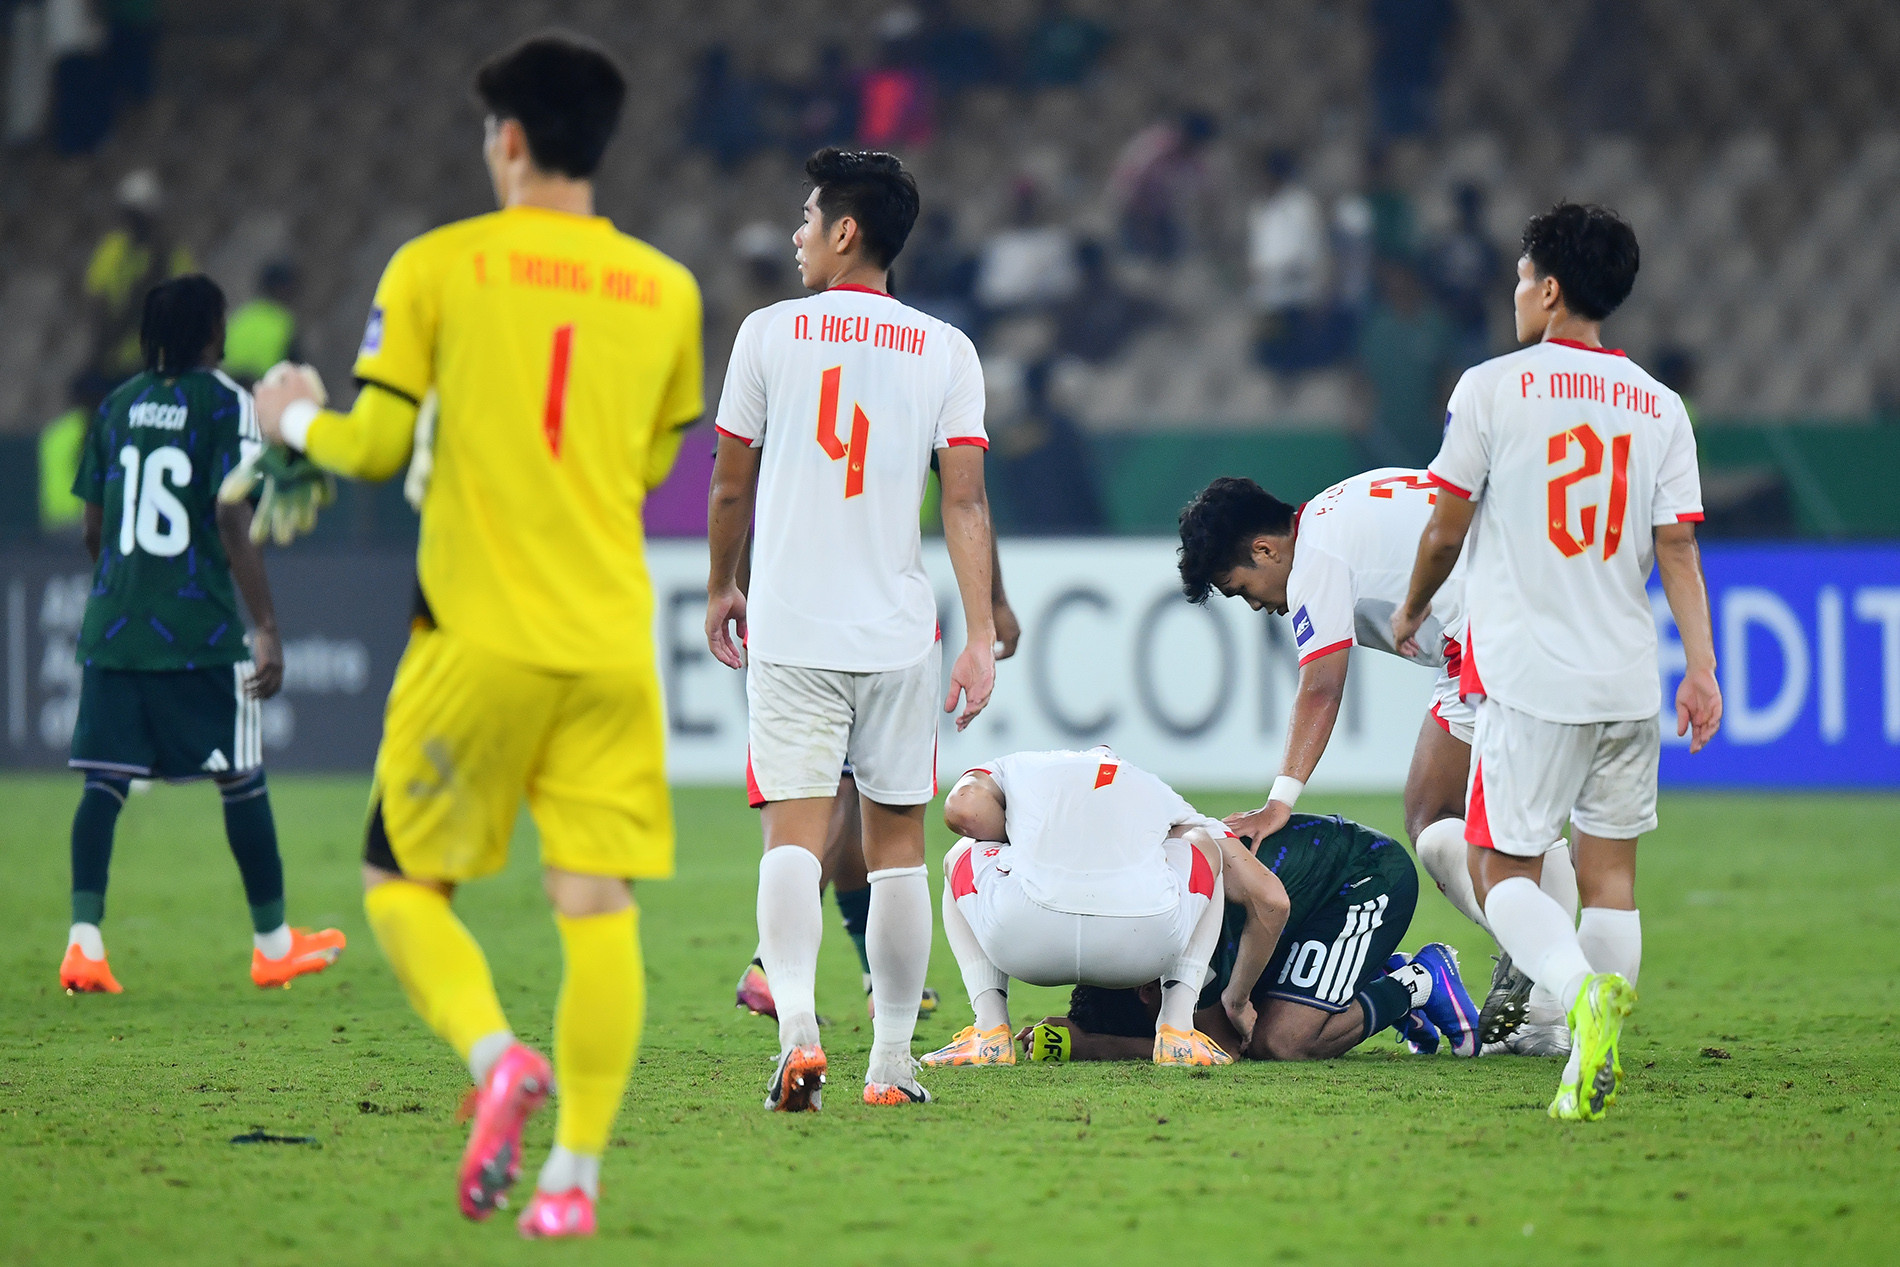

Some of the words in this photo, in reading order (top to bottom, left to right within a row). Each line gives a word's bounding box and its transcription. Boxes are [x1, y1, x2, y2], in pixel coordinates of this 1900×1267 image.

[543, 320, 575, 462] 1
[795, 314, 813, 341] N.
[821, 314, 870, 343] HIEU
[874, 323, 926, 356] MINH
[816, 364, 870, 499] 4
[1521, 371, 1541, 398] P.
[1550, 372, 1605, 403] MINH
[1613, 381, 1661, 419] PHUC
[119, 445, 193, 557] 16
[1547, 422, 1632, 562] 21
[1278, 940, 1327, 988] 10
